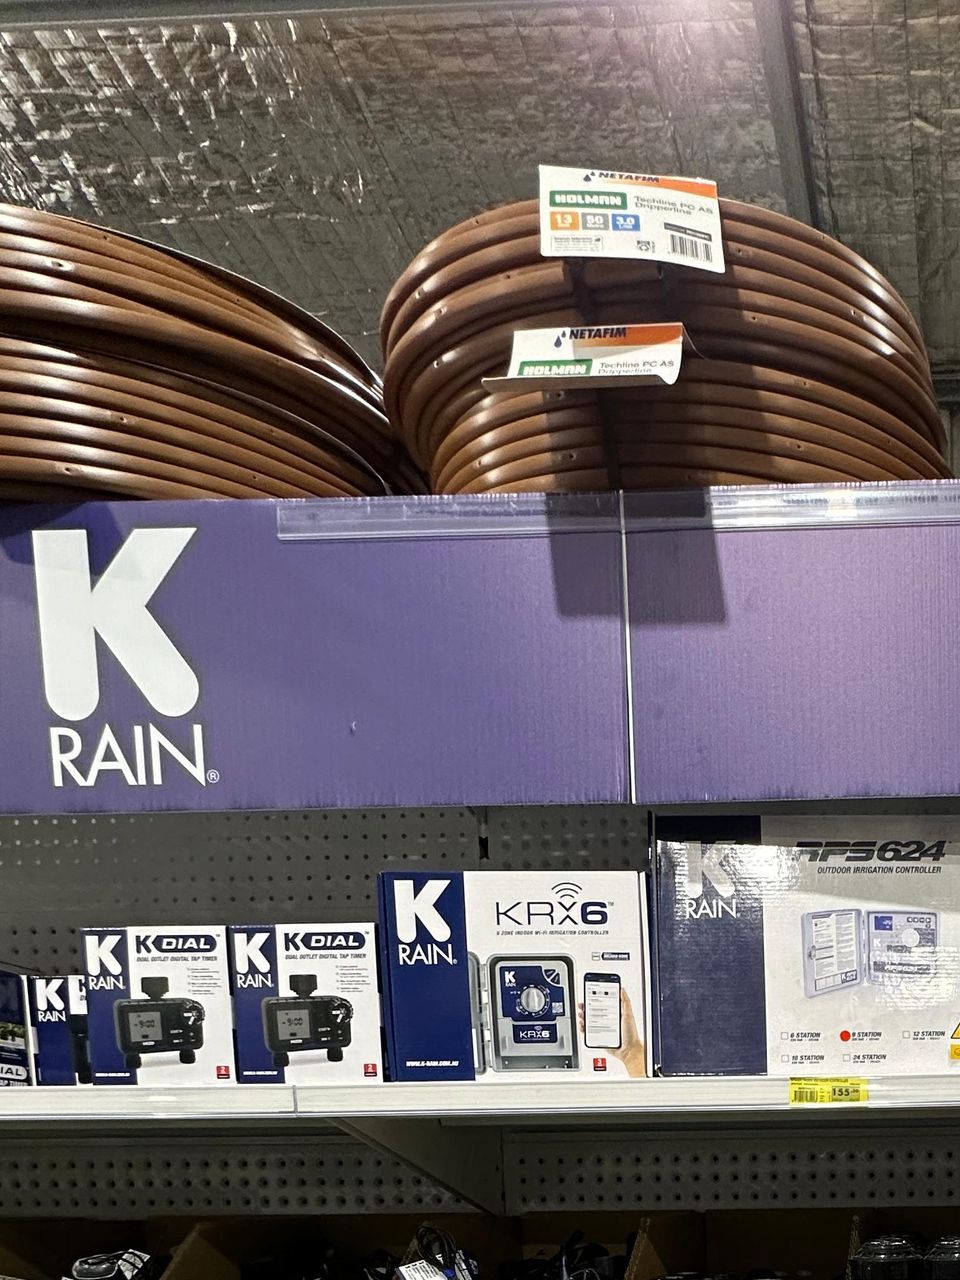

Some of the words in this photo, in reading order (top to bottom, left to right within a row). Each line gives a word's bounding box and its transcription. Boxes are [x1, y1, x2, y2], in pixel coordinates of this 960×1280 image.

[599, 171, 660, 182] NETAFIM
[554, 194, 622, 205] HOLMAN
[635, 196, 677, 207] Techline
[680, 201, 695, 209] PC
[698, 206, 713, 215] AS
[635, 202, 692, 216] Dripperline
[570, 328, 627, 339] NETAFIM
[523, 364, 587, 375] HOLMAN
[600, 361, 639, 369] Techline
[32, 528, 199, 721] K
[796, 840, 946, 862] RPS624
[817, 866, 851, 874] OUTDOOR
[853, 866, 893, 874] IRRIGATION
[394, 880, 451, 943] K
[496, 902, 608, 925] KRX6
[685, 899, 740, 918] RAIN
[162, 938, 210, 949] DIAL
[311, 935, 359, 946] DIAL
[86, 935, 122, 976] K
[234, 933, 271, 974] K
[399, 943, 455, 966] RAIN
[89, 976, 125, 990] RAIN
[237, 974, 274, 988] RAIN
[36, 979, 64, 1010] K
[38, 1011, 66, 1022] RAIN
[833, 1088, 850, 1096] 155
